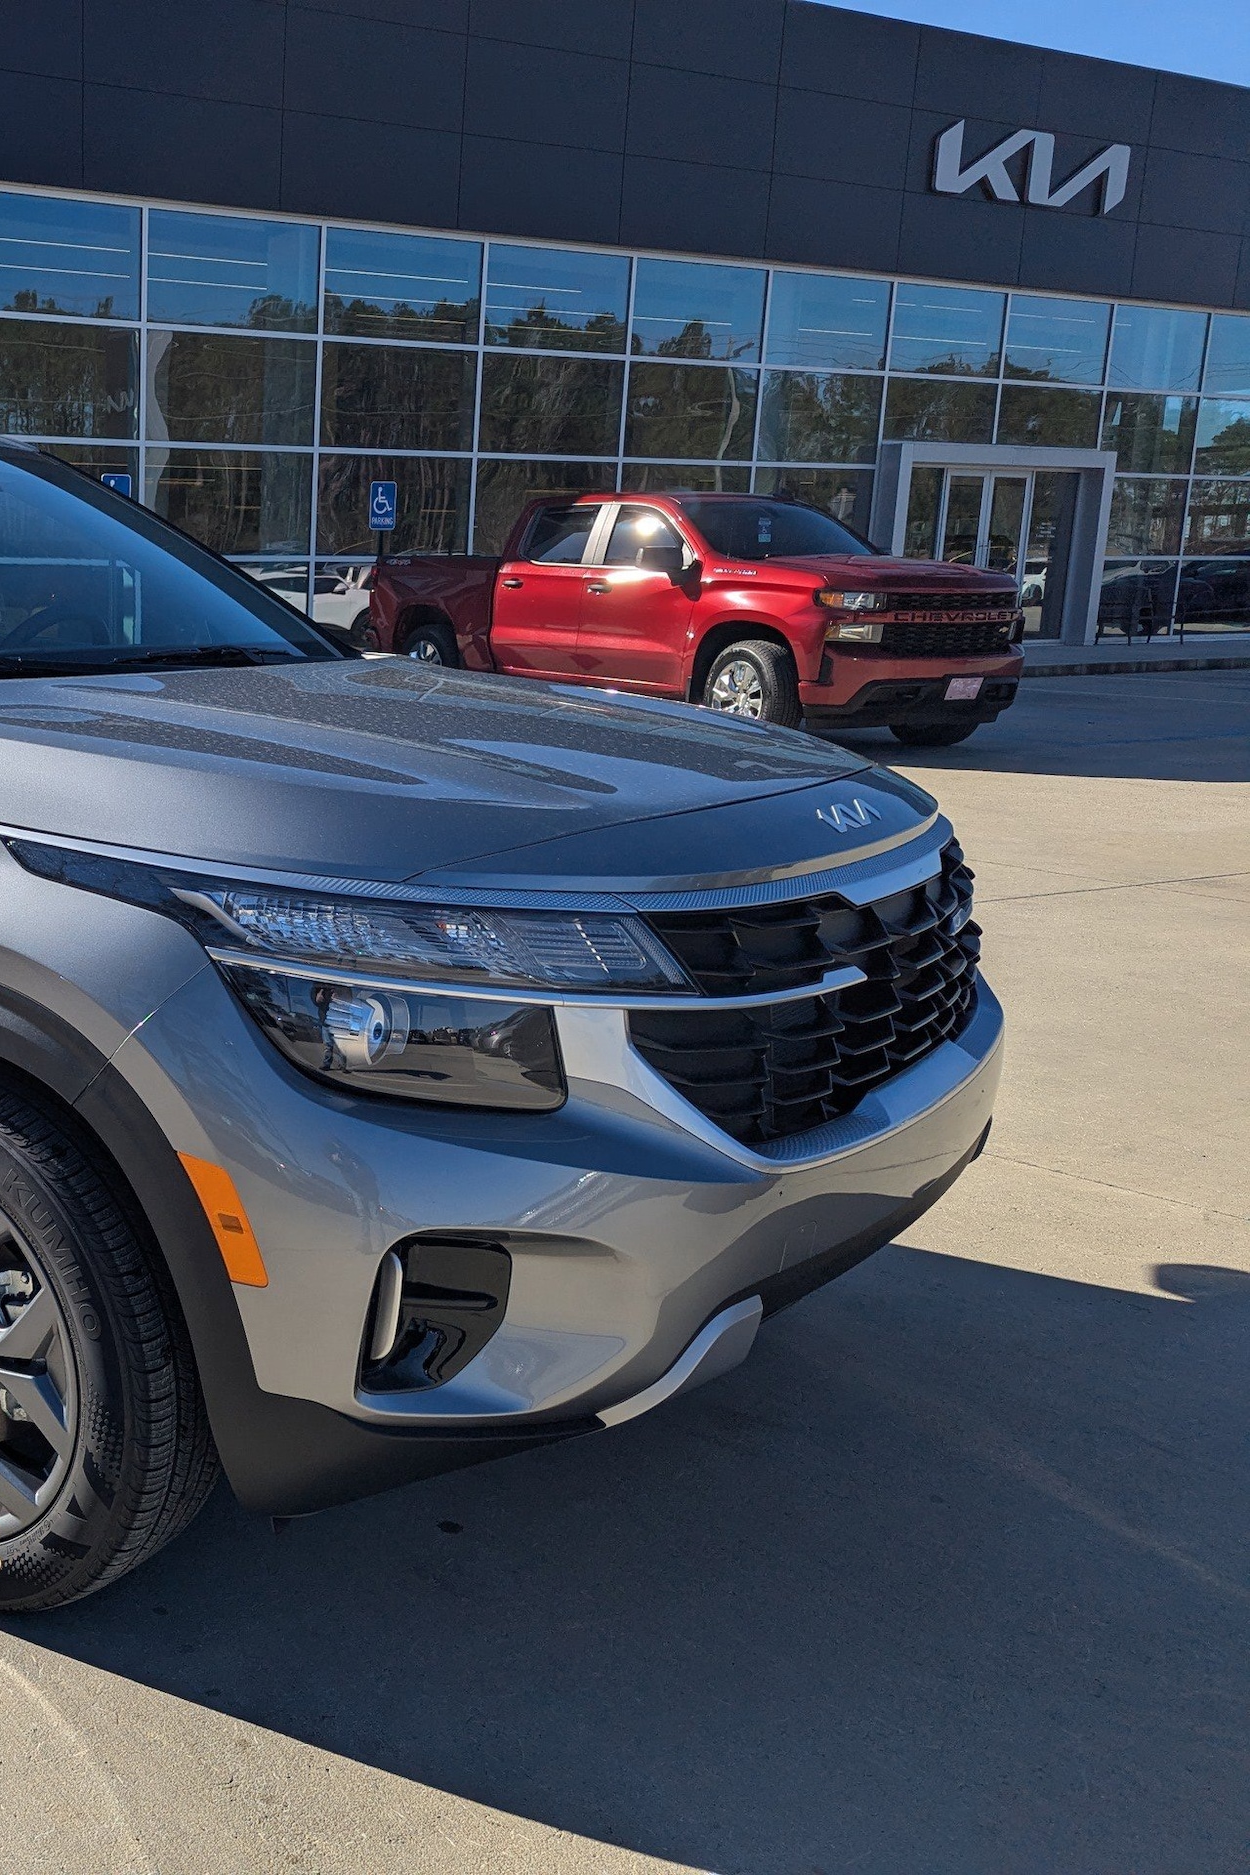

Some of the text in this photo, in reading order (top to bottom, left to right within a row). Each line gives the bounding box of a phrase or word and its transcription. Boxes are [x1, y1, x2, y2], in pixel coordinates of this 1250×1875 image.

[935, 119, 1131, 214] KIA
[371, 516, 394, 525] PARKING
[893, 611, 1017, 622] CHEVROLET
[816, 798, 882, 834] KIA
[2, 1168, 102, 1341] KUMHO
